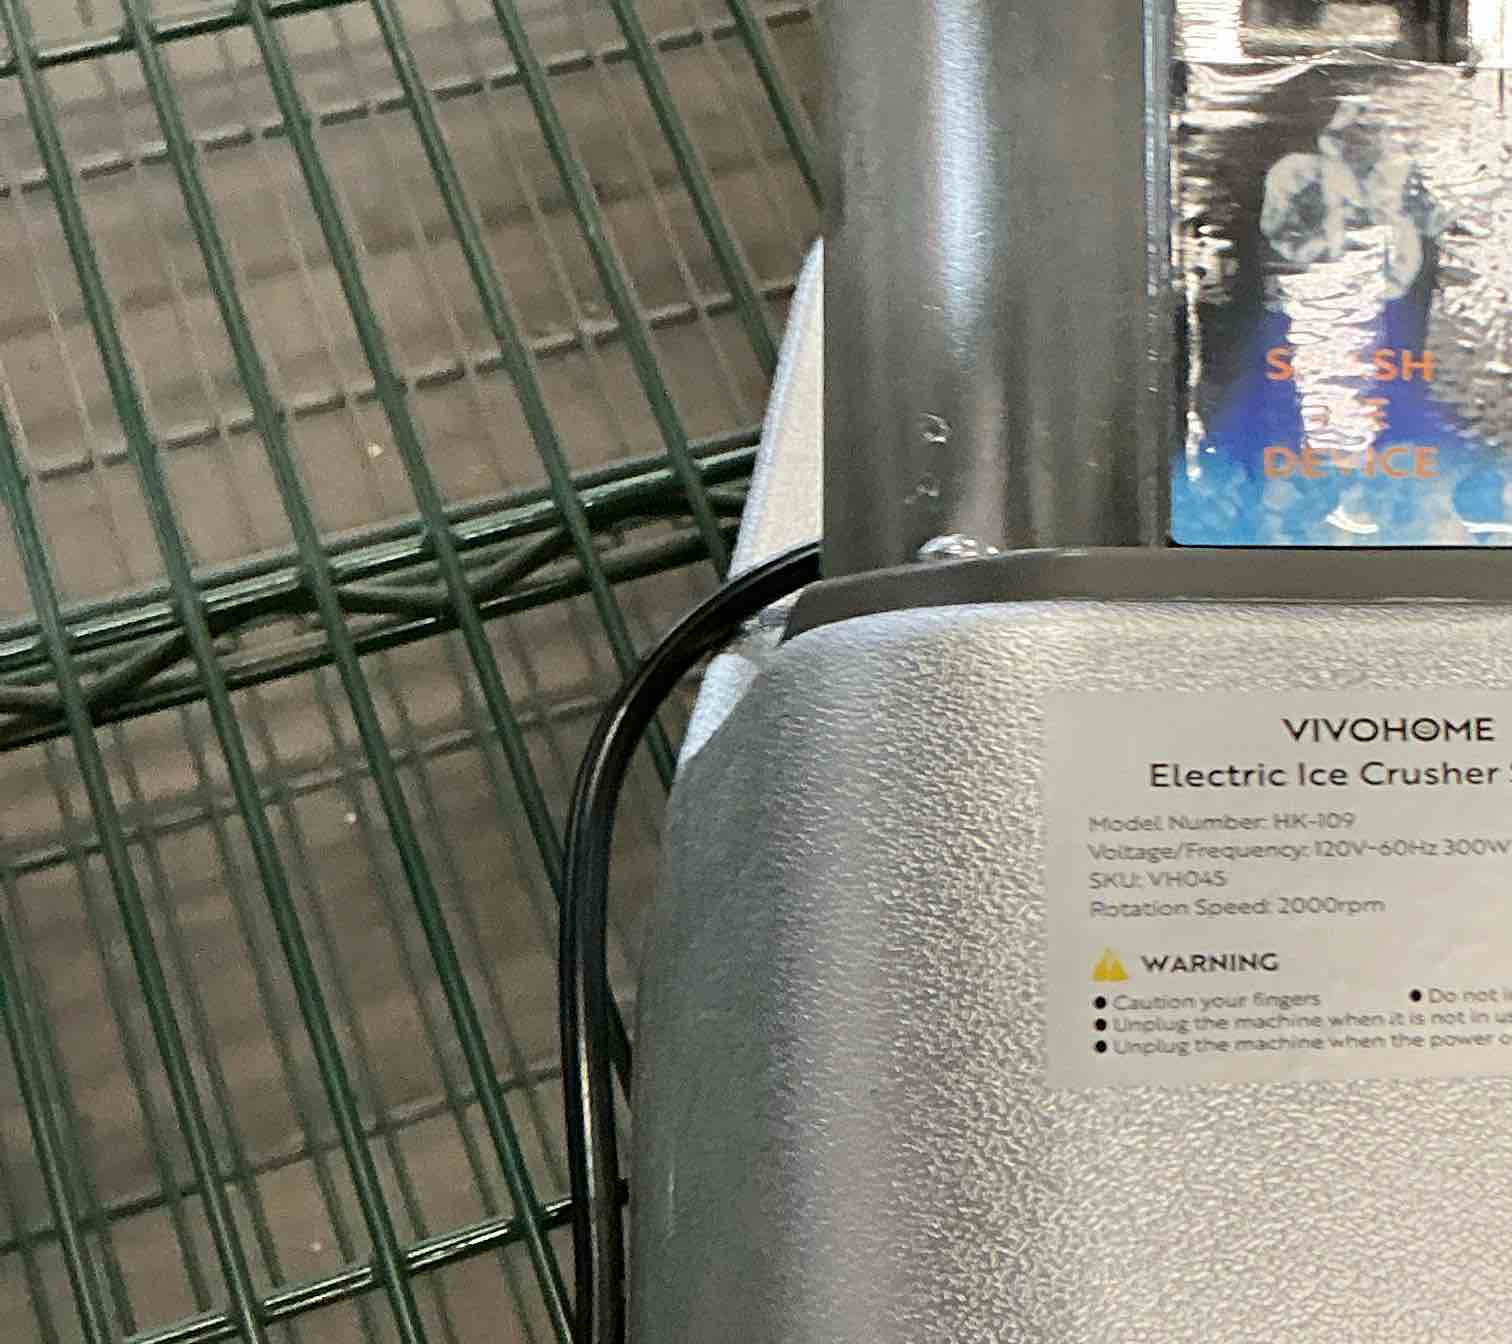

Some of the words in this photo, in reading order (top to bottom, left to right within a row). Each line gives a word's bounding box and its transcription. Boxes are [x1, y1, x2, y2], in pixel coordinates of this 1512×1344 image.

[1265, 346, 1436, 382] SSH
[1281, 717, 1496, 743] VIVOHOME
[1150, 762, 1288, 788] Electric
[1298, 762, 1348, 787] Ice
[1360, 761, 1499, 786] Crusher
[1088, 815, 1164, 832] Model
[1168, 814, 1268, 831] Number:
[1088, 840, 1311, 863] Voltage/Frequency:
[1441, 838, 1512, 856] 300W
[1089, 871, 1143, 889] SKU:
[1090, 899, 1189, 917] Rotation
[1277, 896, 1386, 917] 2000rpm
[1140, 952, 1279, 973] WARNING
[1112, 994, 1197, 1011] Caution
[1201, 996, 1247, 1012] your
[1253, 992, 1320, 1010] fingers
[1428, 987, 1457, 1004] Do
[1463, 987, 1498, 1002] not
[1112, 1016, 1189, 1034] Unplug
[1194, 1015, 1230, 1030] the
[1234, 1014, 1322, 1030] machine
[1328, 1012, 1386, 1027] when
[1409, 1012, 1425, 1025] is
[1431, 1011, 1466, 1025] not
[1470, 1009, 1490, 1025] in
[1112, 1039, 1190, 1057] Unplug
[1194, 1038, 1230, 1052] the
[1234, 1036, 1324, 1052] machine
[1328, 1034, 1387, 1049] when
[1390, 1033, 1425, 1048] the
[1430, 1032, 1494, 1051] power
